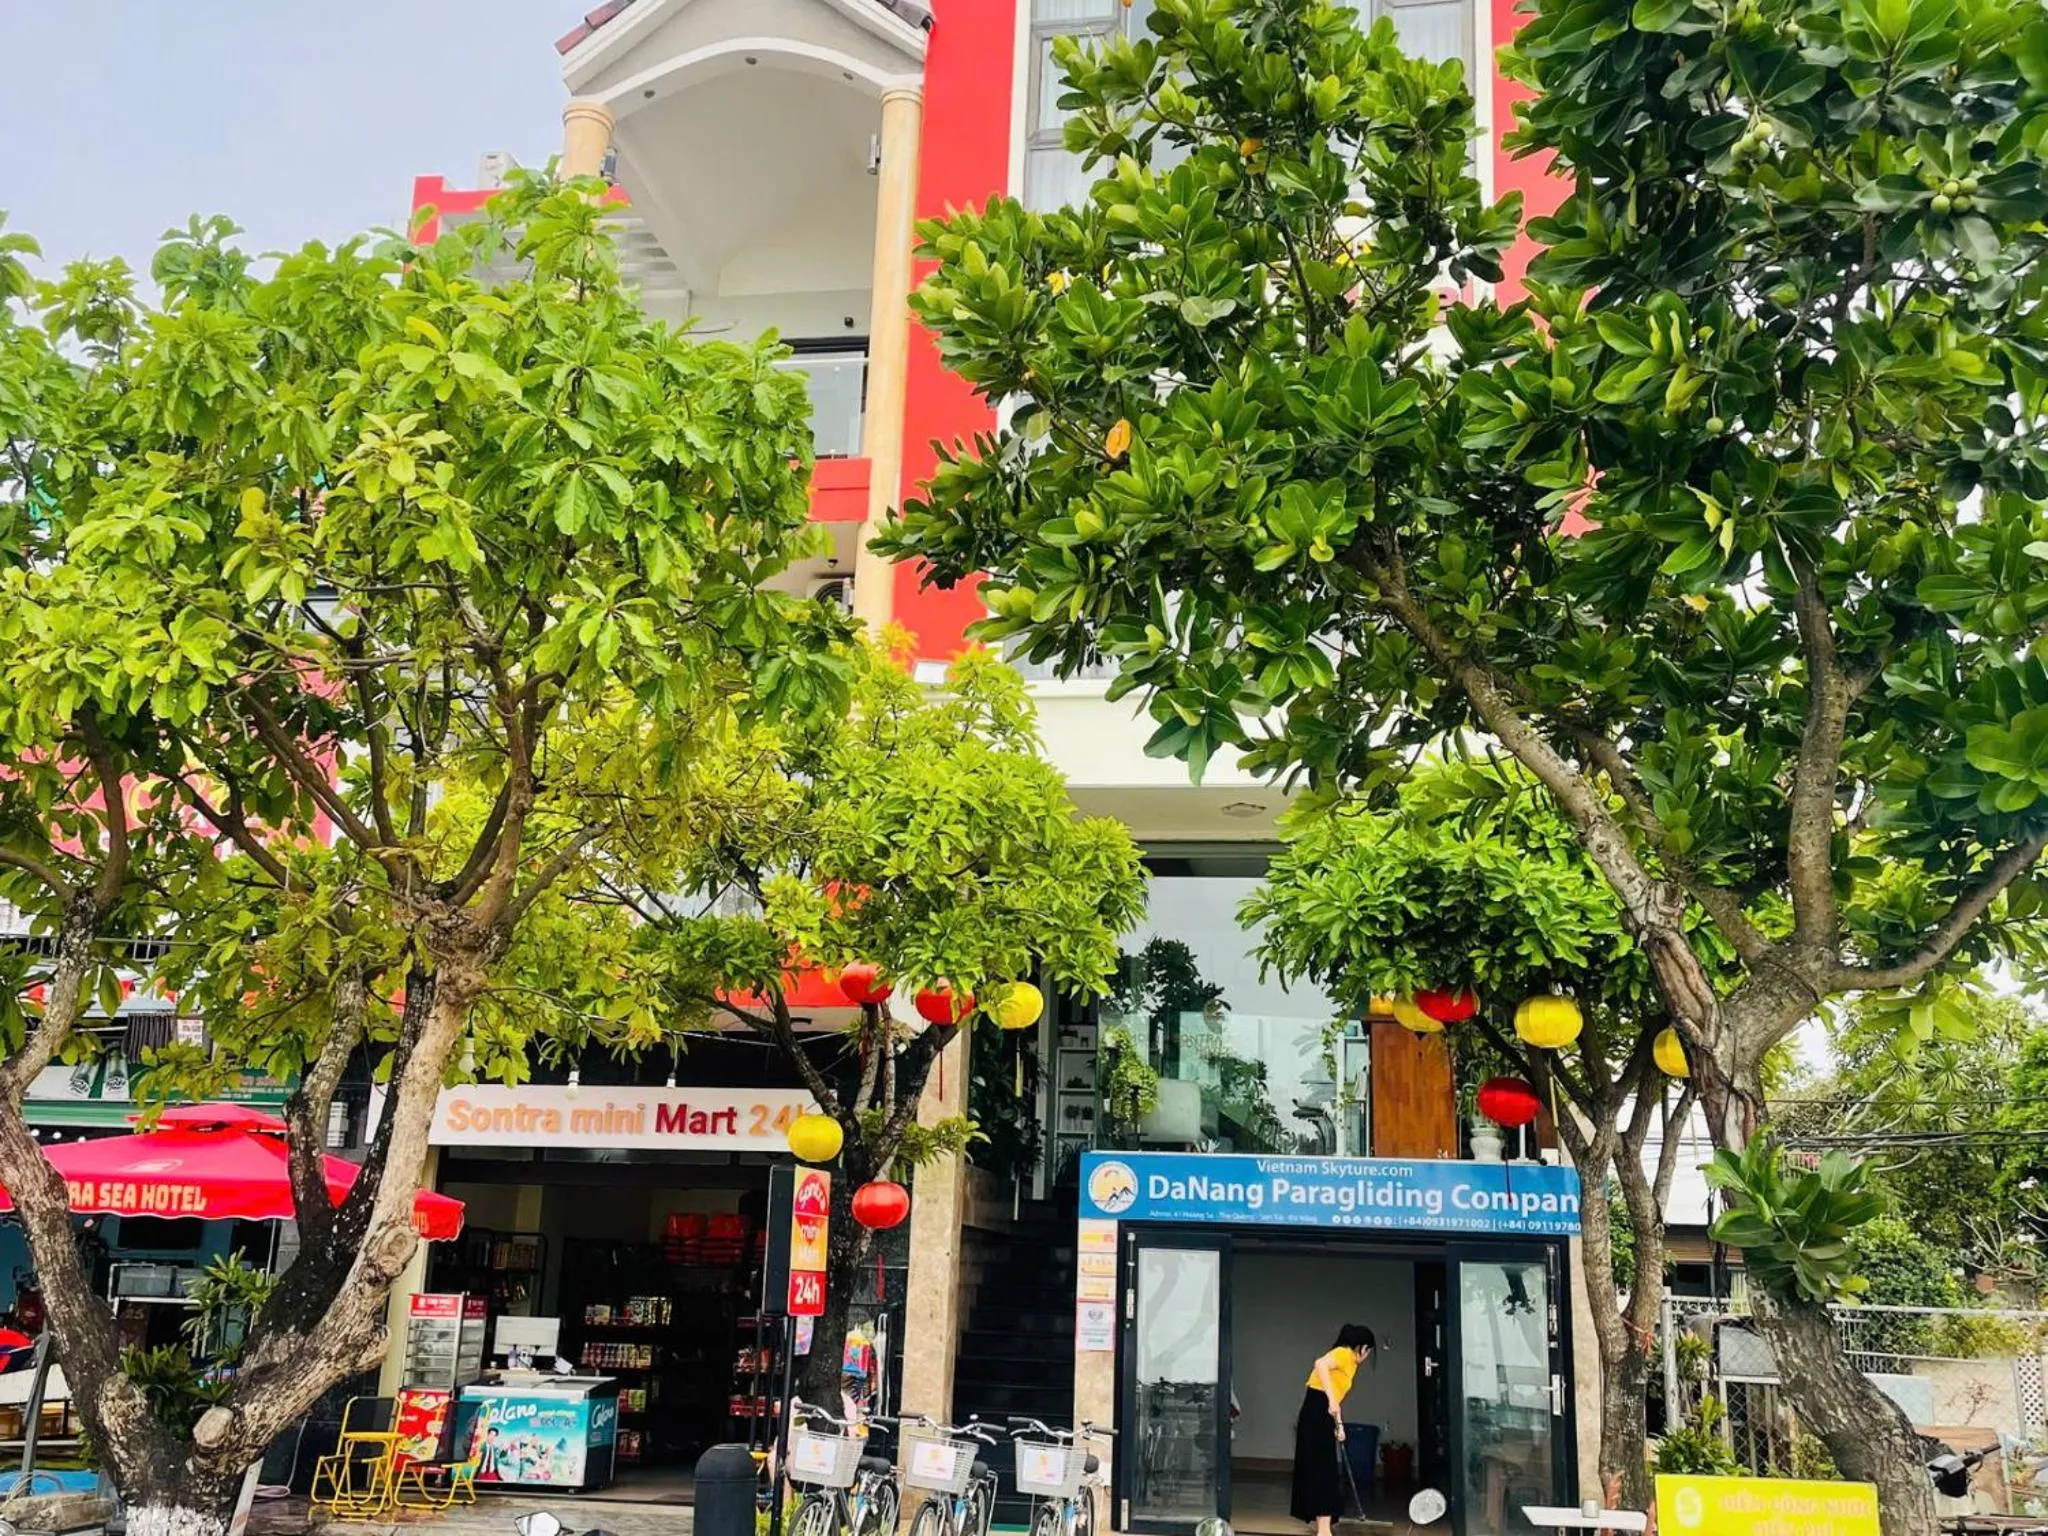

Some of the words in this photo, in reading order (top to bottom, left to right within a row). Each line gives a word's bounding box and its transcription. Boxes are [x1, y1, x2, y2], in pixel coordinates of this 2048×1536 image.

[447, 1099, 560, 1133] Sontra
[569, 1102, 646, 1134] mini
[655, 1103, 738, 1136] Mart
[1257, 1160, 1318, 1175] Vietnam
[1322, 1162, 1413, 1179] Skyture.com
[98, 1182, 137, 1209] SEA
[141, 1184, 207, 1212] HOTEL
[1148, 1175, 1264, 1209] DaNang
[1272, 1178, 1443, 1214] Paragliding
[794, 1275, 820, 1305] 24h
